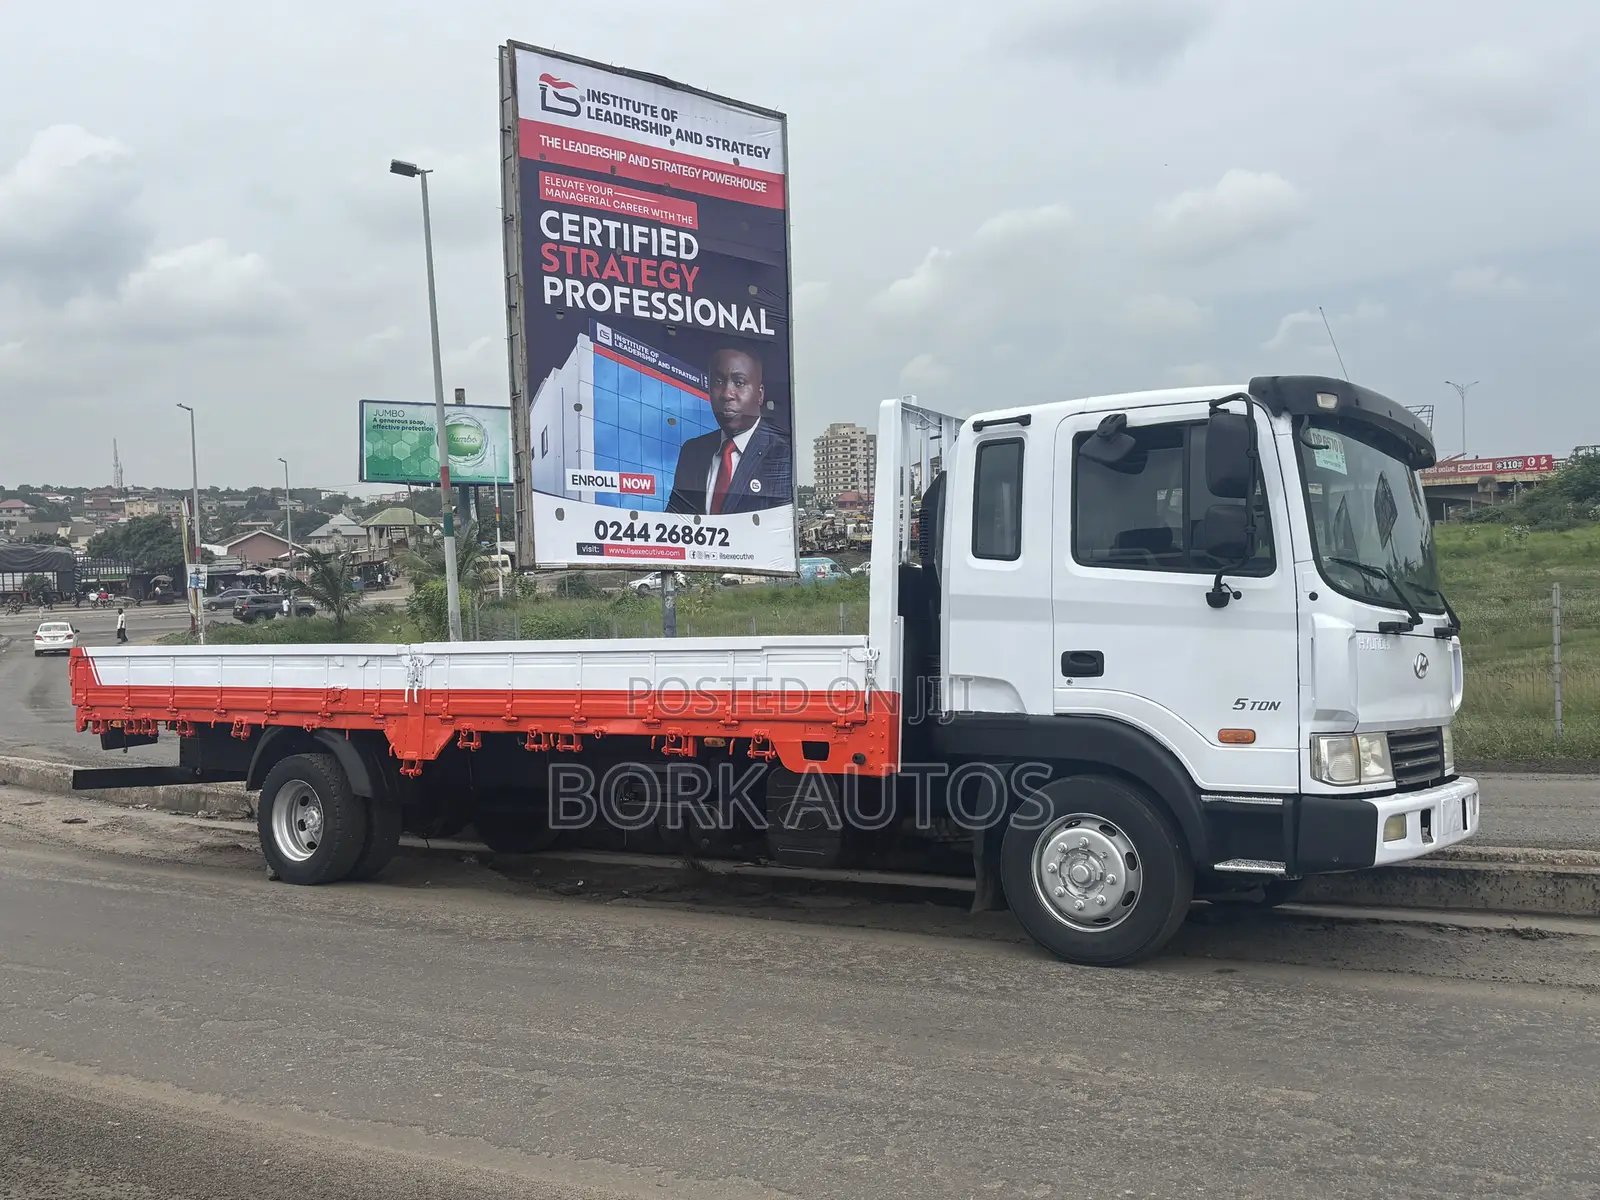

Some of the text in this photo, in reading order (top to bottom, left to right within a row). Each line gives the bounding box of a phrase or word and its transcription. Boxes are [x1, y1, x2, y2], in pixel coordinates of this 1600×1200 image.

[587, 88, 678, 122] INSTITUTE OF
[587, 106, 771, 159] LEADERSHIP AND STRATEGY
[540, 134, 767, 193] THE LEADERSHIP AND STRATEGY POWERHOUSE
[545, 176, 614, 197] ELEVATE YOUR
[545, 187, 693, 225] MANAGERIAL CAREER WITH THE
[540, 210, 699, 260] CERTIFIED
[541, 243, 700, 292] STRATEGY
[543, 275, 775, 336] PROFESSIONAL
[614, 333, 660, 358] INSTITUTE OF
[614, 340, 657, 363] LEADERSHIP
[658, 360, 671, 370] AND
[671, 366, 700, 383] STRATEGY
[373, 409, 405, 418] JUMBO
[571, 474, 651, 490] ENROLL NOW
[594, 520, 730, 547] 0244 268672
[582, 545, 600, 553] visit:
[1358, 636, 1391, 651] HYUNDA
[1232, 698, 1281, 711] 5 TON
